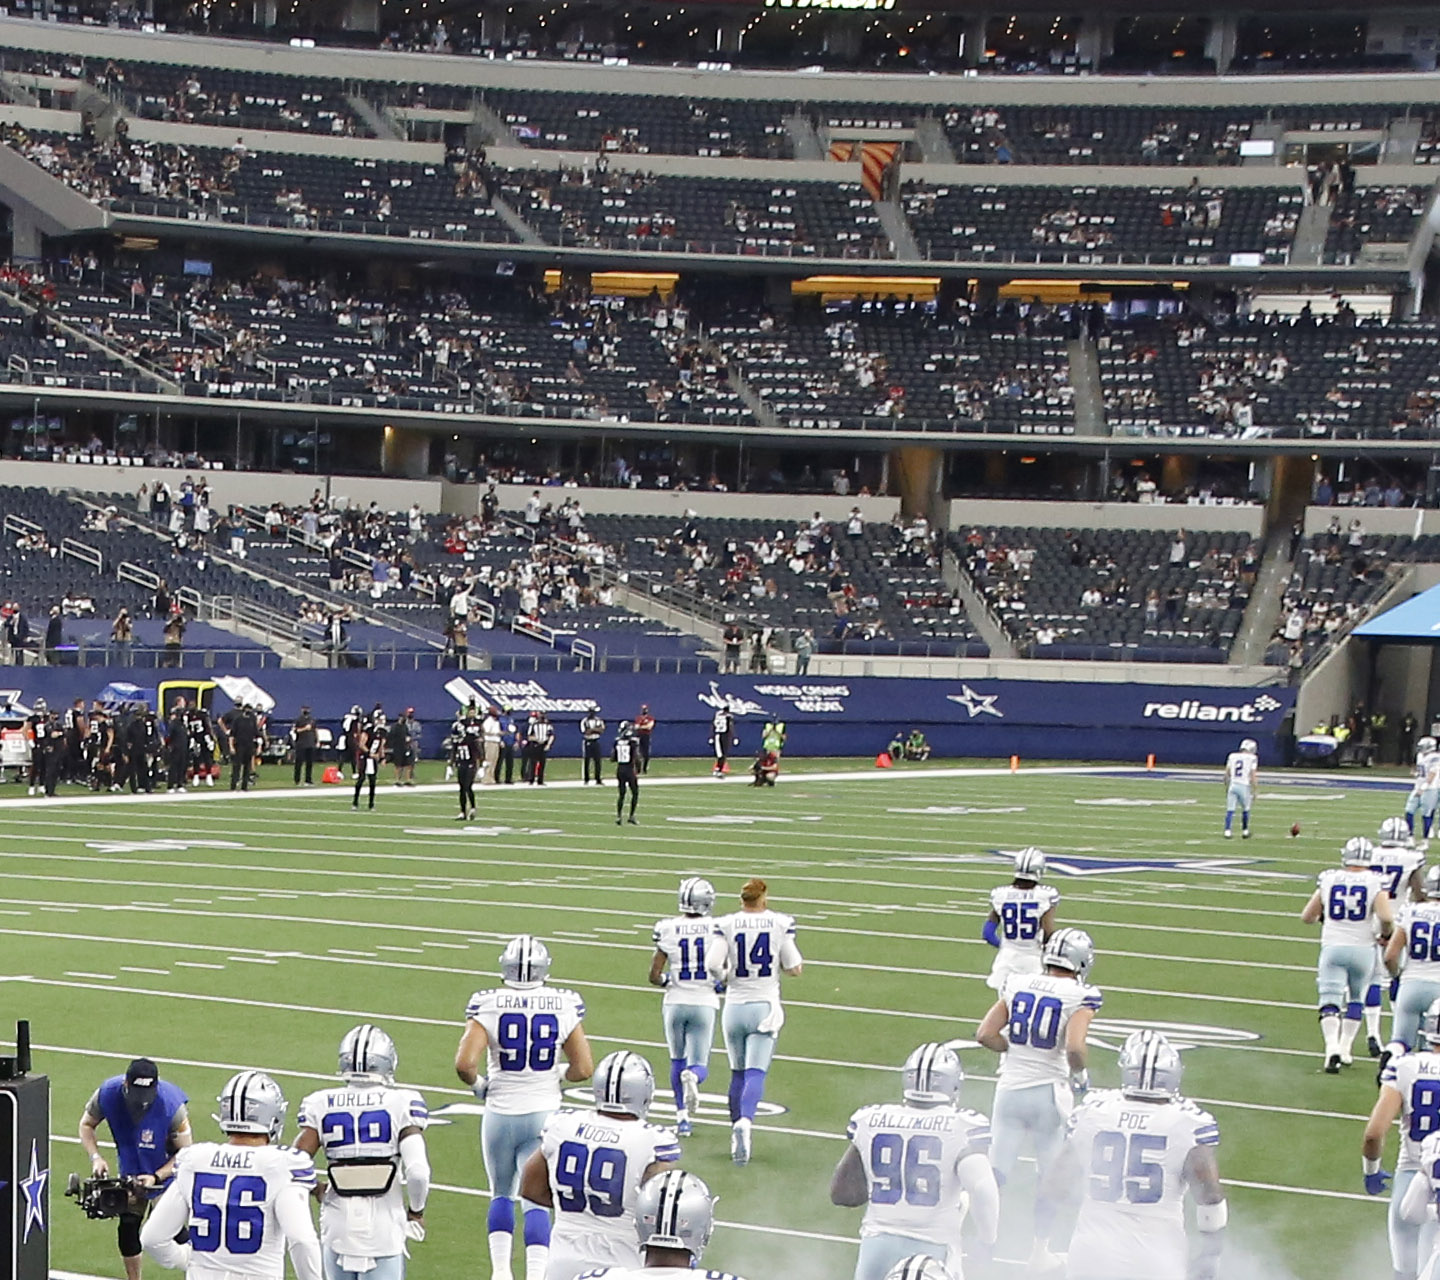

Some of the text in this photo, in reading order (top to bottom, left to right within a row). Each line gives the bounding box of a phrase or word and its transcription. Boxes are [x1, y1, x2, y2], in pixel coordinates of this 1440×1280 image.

[1234, 760, 1244, 777] 2
[1000, 902, 1040, 941] 85
[1329, 884, 1368, 921] 63
[734, 915, 775, 930] DALTON
[678, 936, 708, 981] 11
[734, 932, 774, 979] 14
[495, 994, 563, 1012] CRAWFORD
[1007, 990, 1063, 1050] 80
[497, 1012, 560, 1072] 98
[326, 1092, 388, 1109] WORLEY
[575, 1122, 622, 1144] WOODS
[867, 1112, 954, 1133] GALLIMORE
[1117, 1111, 1150, 1130] POE
[210, 1150, 255, 1169] ANAE
[869, 1132, 943, 1207] 96
[1090, 1131, 1168, 1205] 95
[555, 1140, 628, 1218] 99
[188, 1171, 267, 1255] 56
